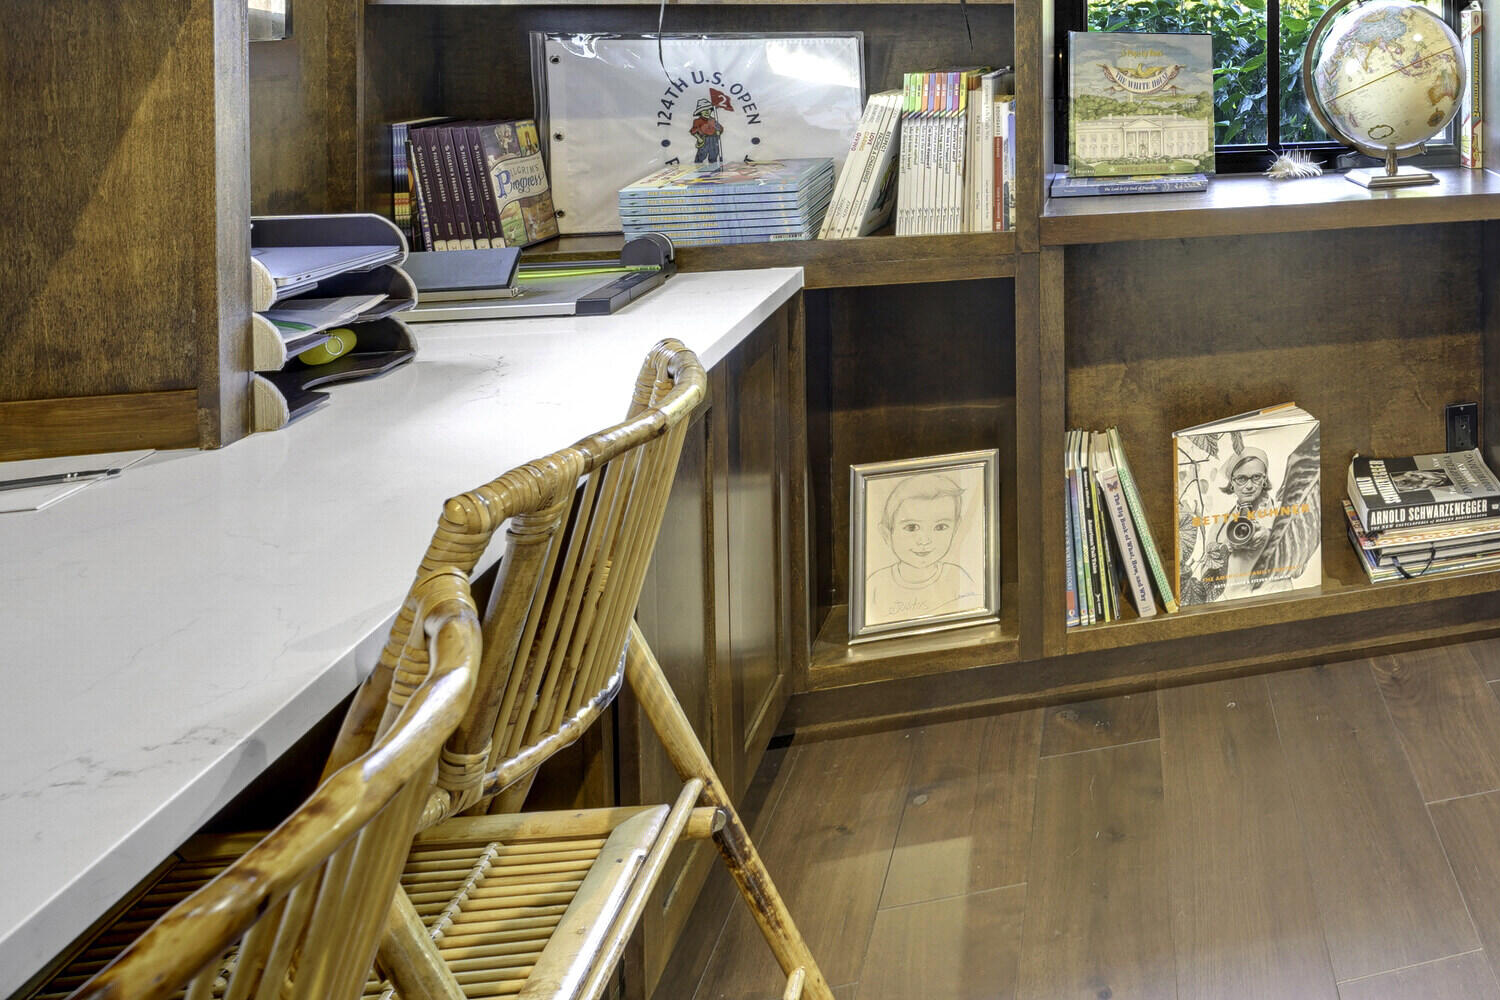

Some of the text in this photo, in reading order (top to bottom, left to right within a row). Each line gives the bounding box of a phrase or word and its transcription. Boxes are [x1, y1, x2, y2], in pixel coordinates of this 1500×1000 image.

[1115, 71, 1169, 90] THE WHITE HOUSE
[657, 71, 761, 126] 124TH U.S. OPEN
[718, 94, 729, 108] 2
[850, 131, 861, 152] GIVING
[858, 130, 869, 151] CARING
[866, 131, 875, 145] LOVE
[872, 131, 883, 151] FACING
[879, 130, 891, 153] RESPECT
[861, 154, 875, 184] CHALLENGE
[423, 178, 432, 203] PROGRESS
[1113, 493, 1122, 505] The
[1116, 505, 1125, 517] Big
[1192, 504, 1310, 527] BETTY KUHNER
[1371, 499, 1488, 526] ARNOLD SCHWARZENEGGER
[1119, 517, 1129, 534] Book
[1125, 540, 1136, 560] What,
[1130, 559, 1140, 575] How,
[1134, 575, 1143, 587] and
[1137, 586, 1147, 602] Why
